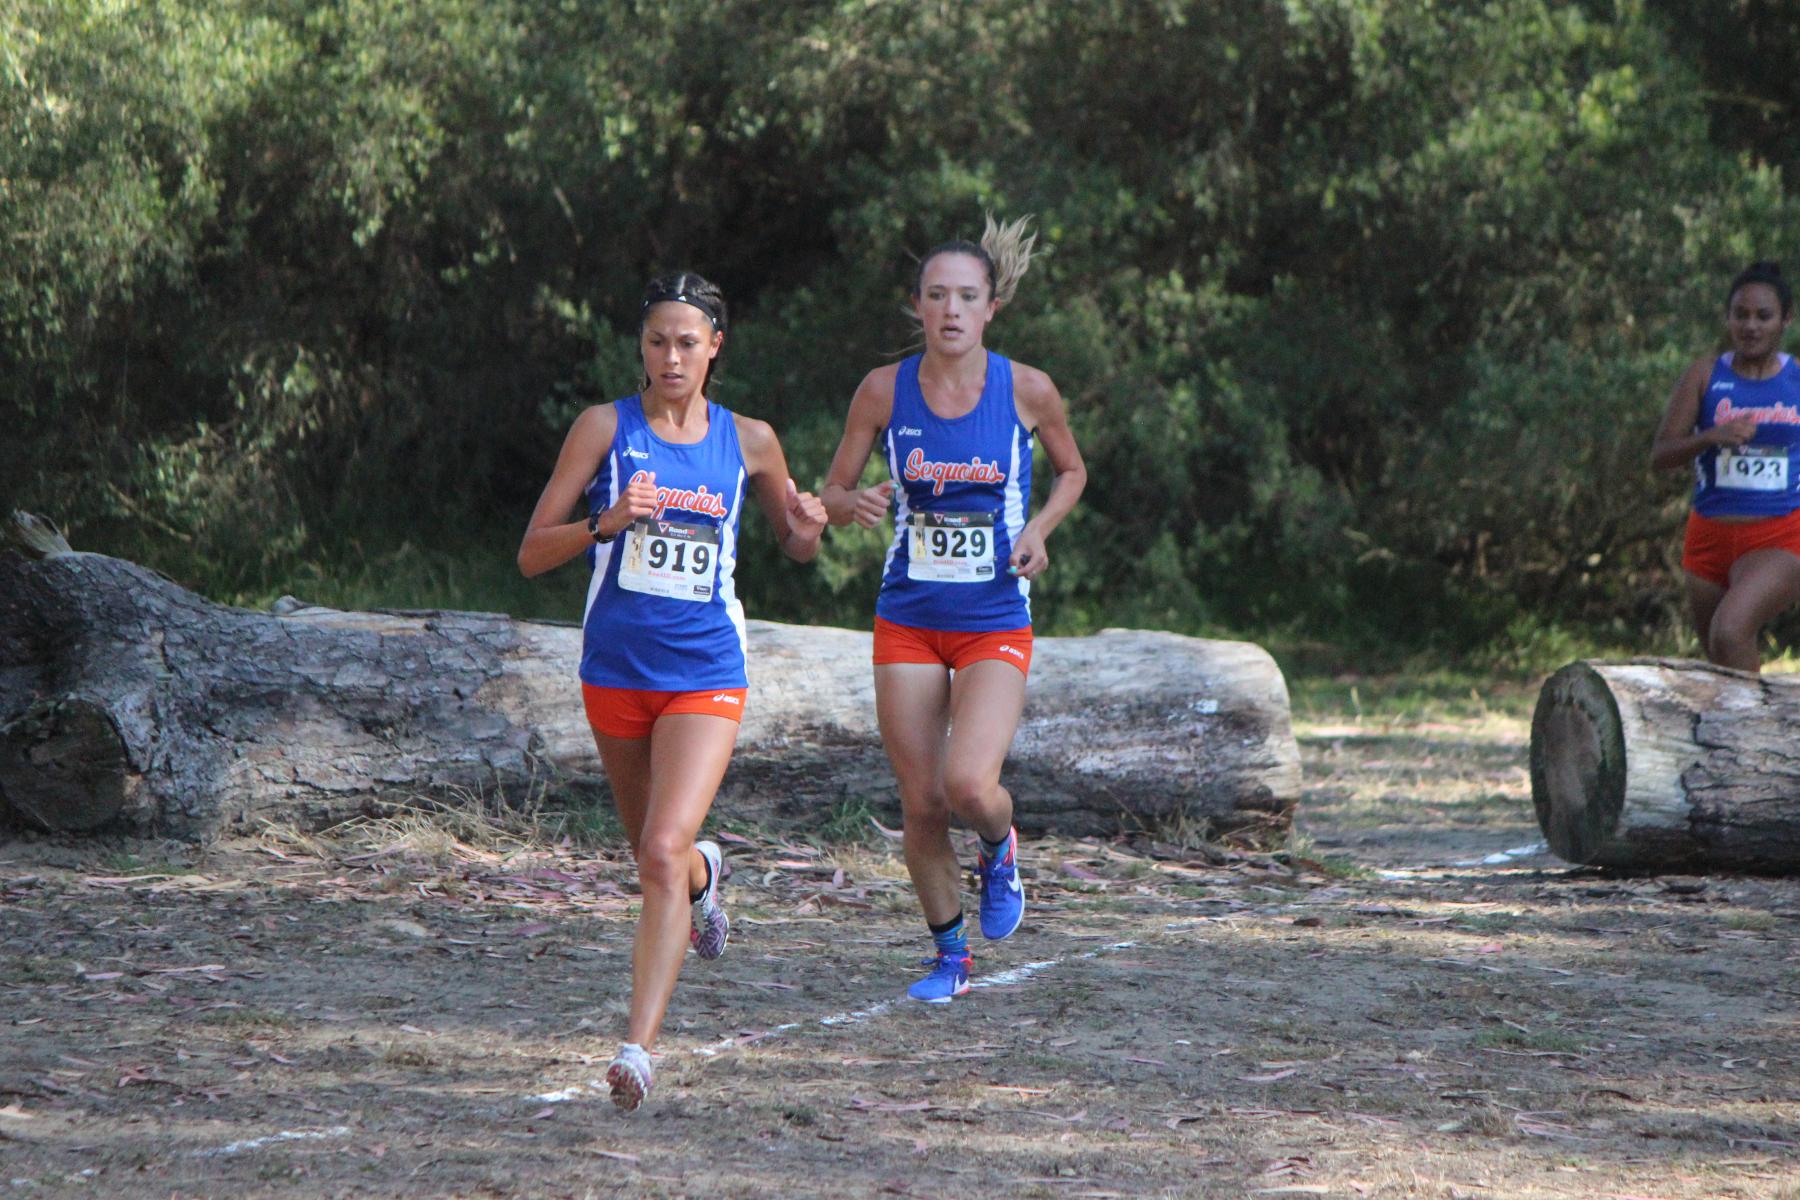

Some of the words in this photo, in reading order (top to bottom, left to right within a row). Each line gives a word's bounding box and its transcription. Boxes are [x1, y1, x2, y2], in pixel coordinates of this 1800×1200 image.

[904, 447, 1006, 497] Sequoias
[1736, 459, 1781, 478] 923
[648, 539, 710, 575] 919
[932, 529, 986, 557] 929
